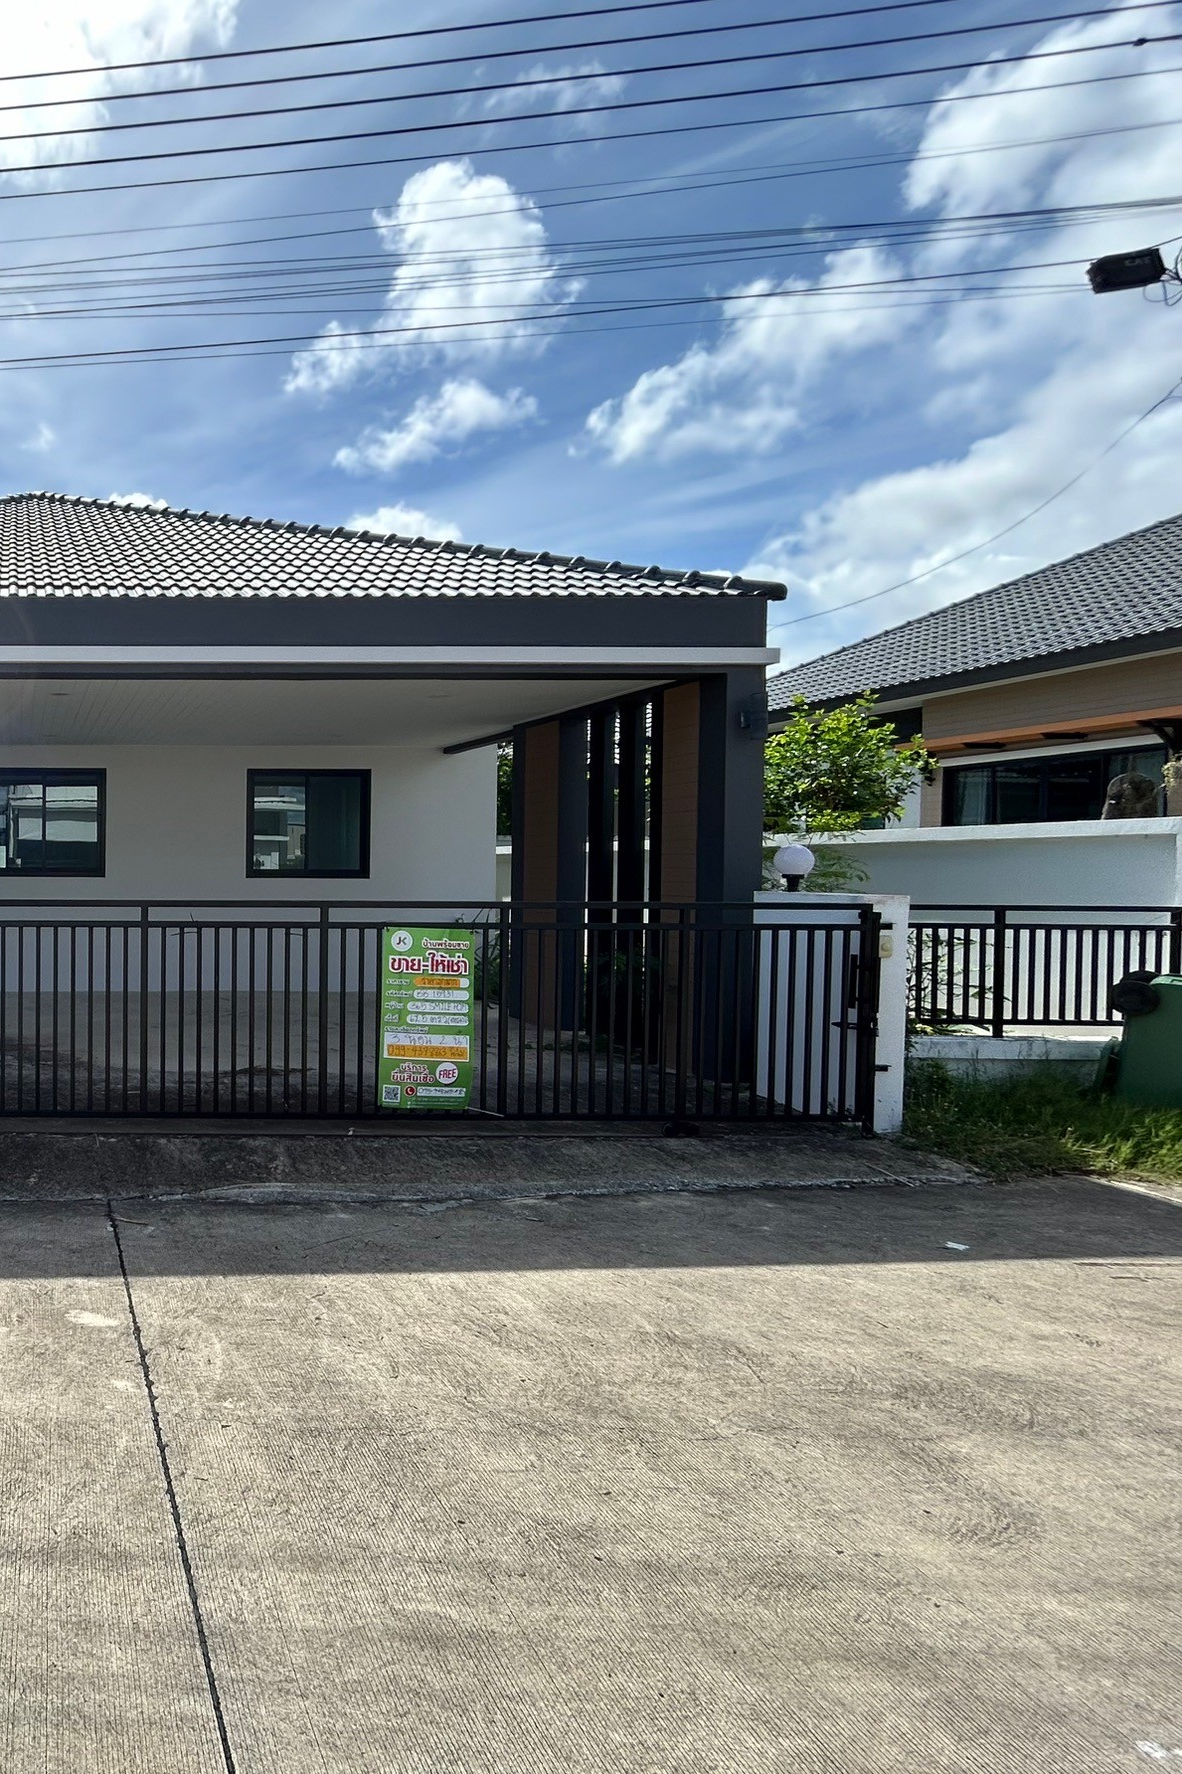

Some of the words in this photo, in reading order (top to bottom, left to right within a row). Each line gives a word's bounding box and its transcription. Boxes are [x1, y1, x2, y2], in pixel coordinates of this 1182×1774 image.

[390, 952, 468, 973] ขาย-ให้เช่า
[400, 1062, 427, 1072] บริการ
[392, 1070, 435, 1083] ยื่นสินเชื่อ
[438, 1068, 457, 1080] FREE
